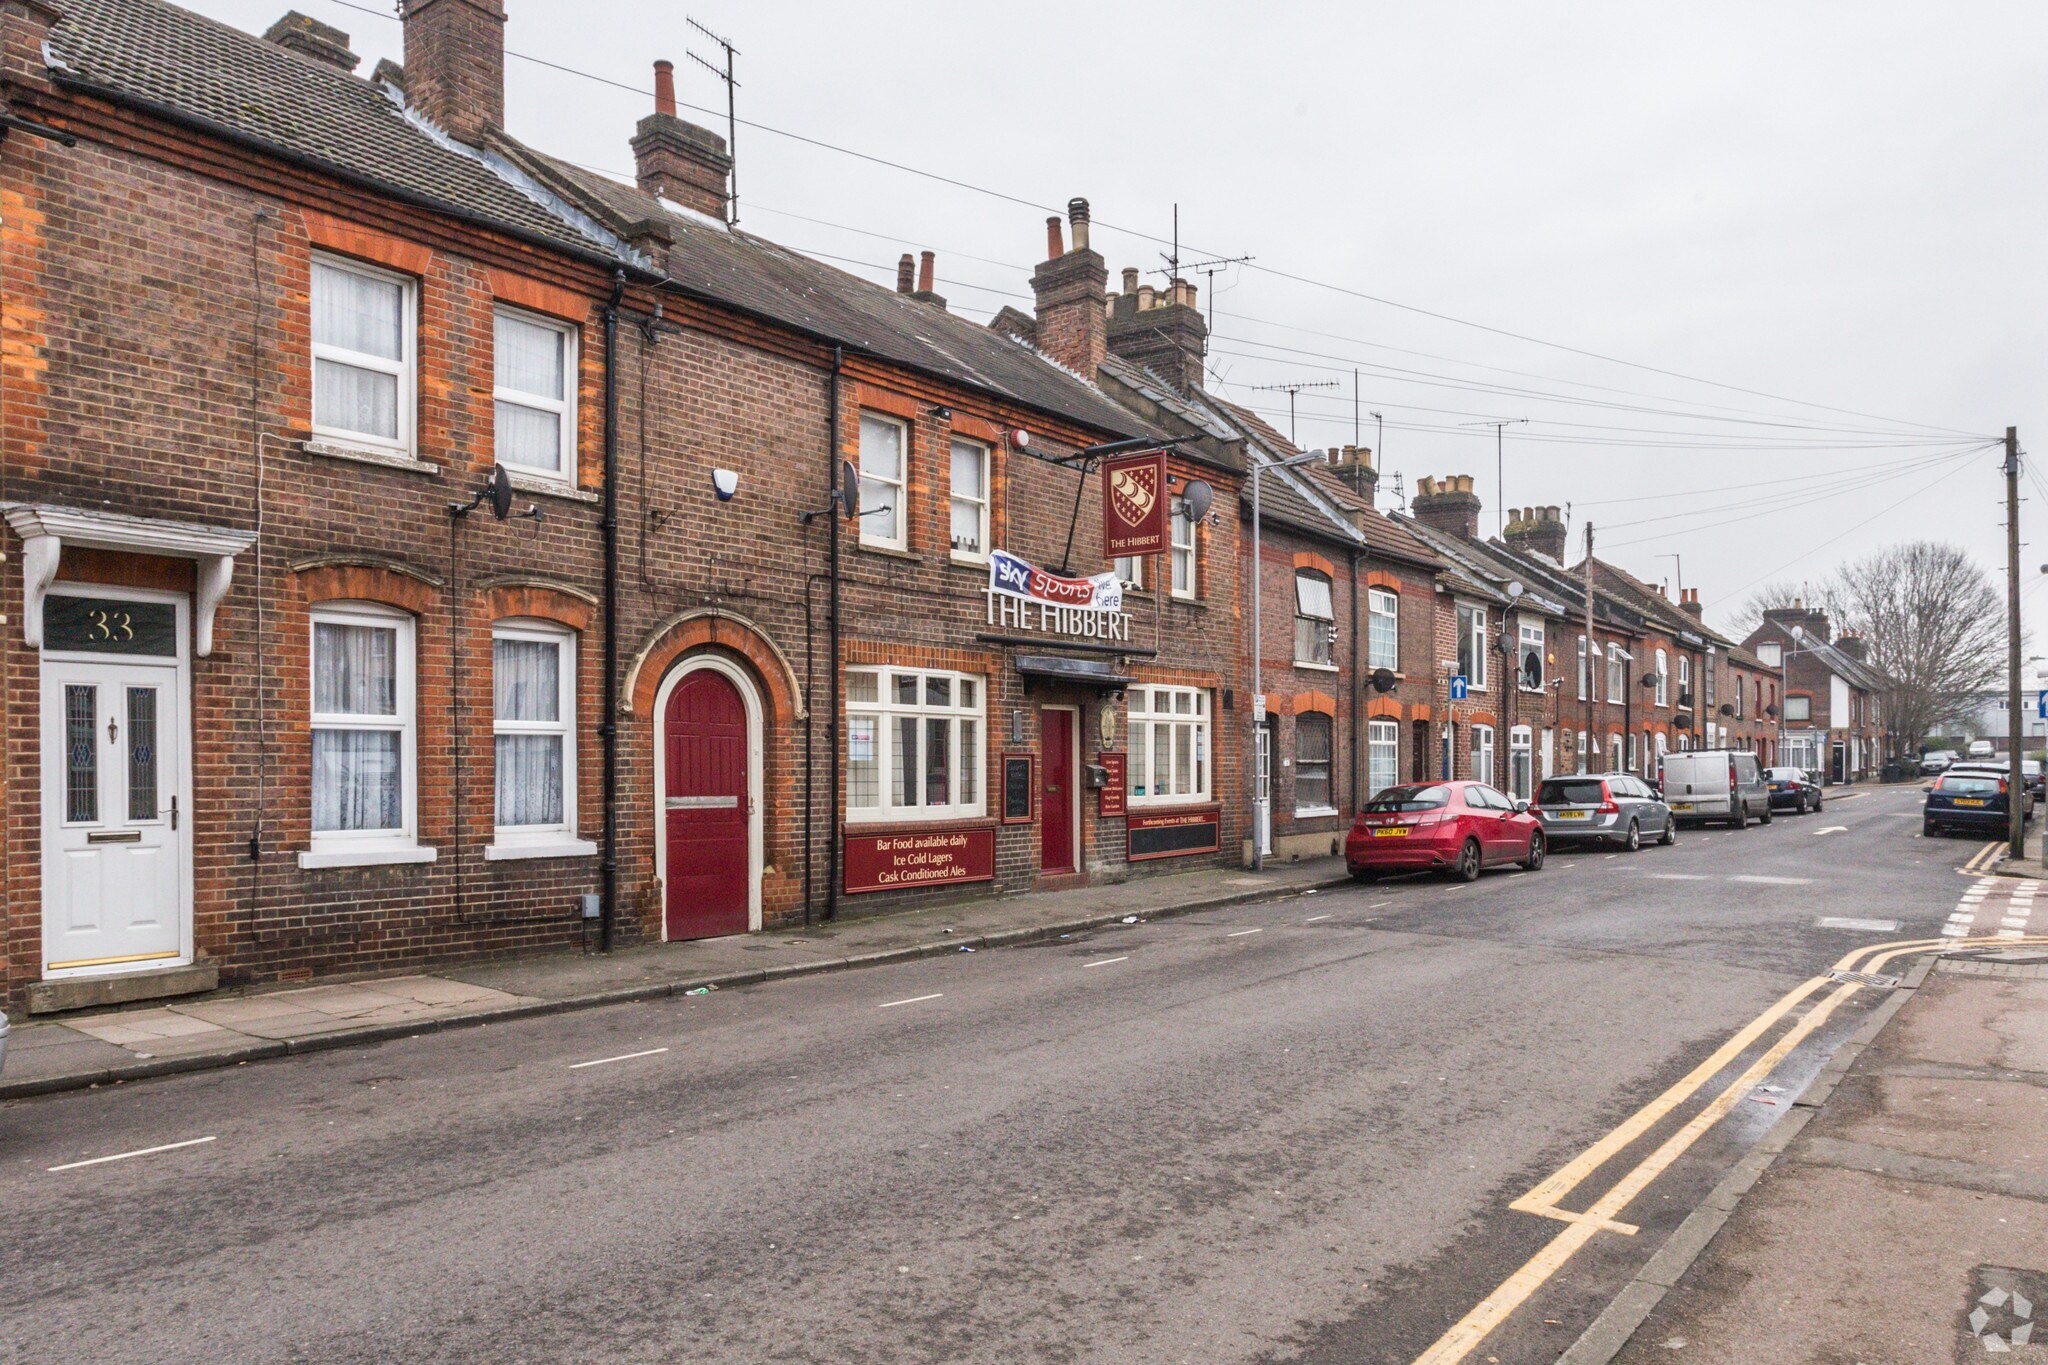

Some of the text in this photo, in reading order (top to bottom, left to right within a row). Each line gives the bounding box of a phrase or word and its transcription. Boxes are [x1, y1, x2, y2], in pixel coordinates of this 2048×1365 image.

[1110, 534, 1160, 549] THE HIBBERT
[999, 560, 1030, 591] sky
[1096, 592, 1119, 607] here
[981, 587, 1133, 642] THE HIBBERT
[89, 610, 134, 642] 33
[877, 834, 968, 850] Bar Food available daily
[894, 852, 952, 866] Ice Cold Lagers
[878, 865, 966, 883] Cask Conditioned Ales
